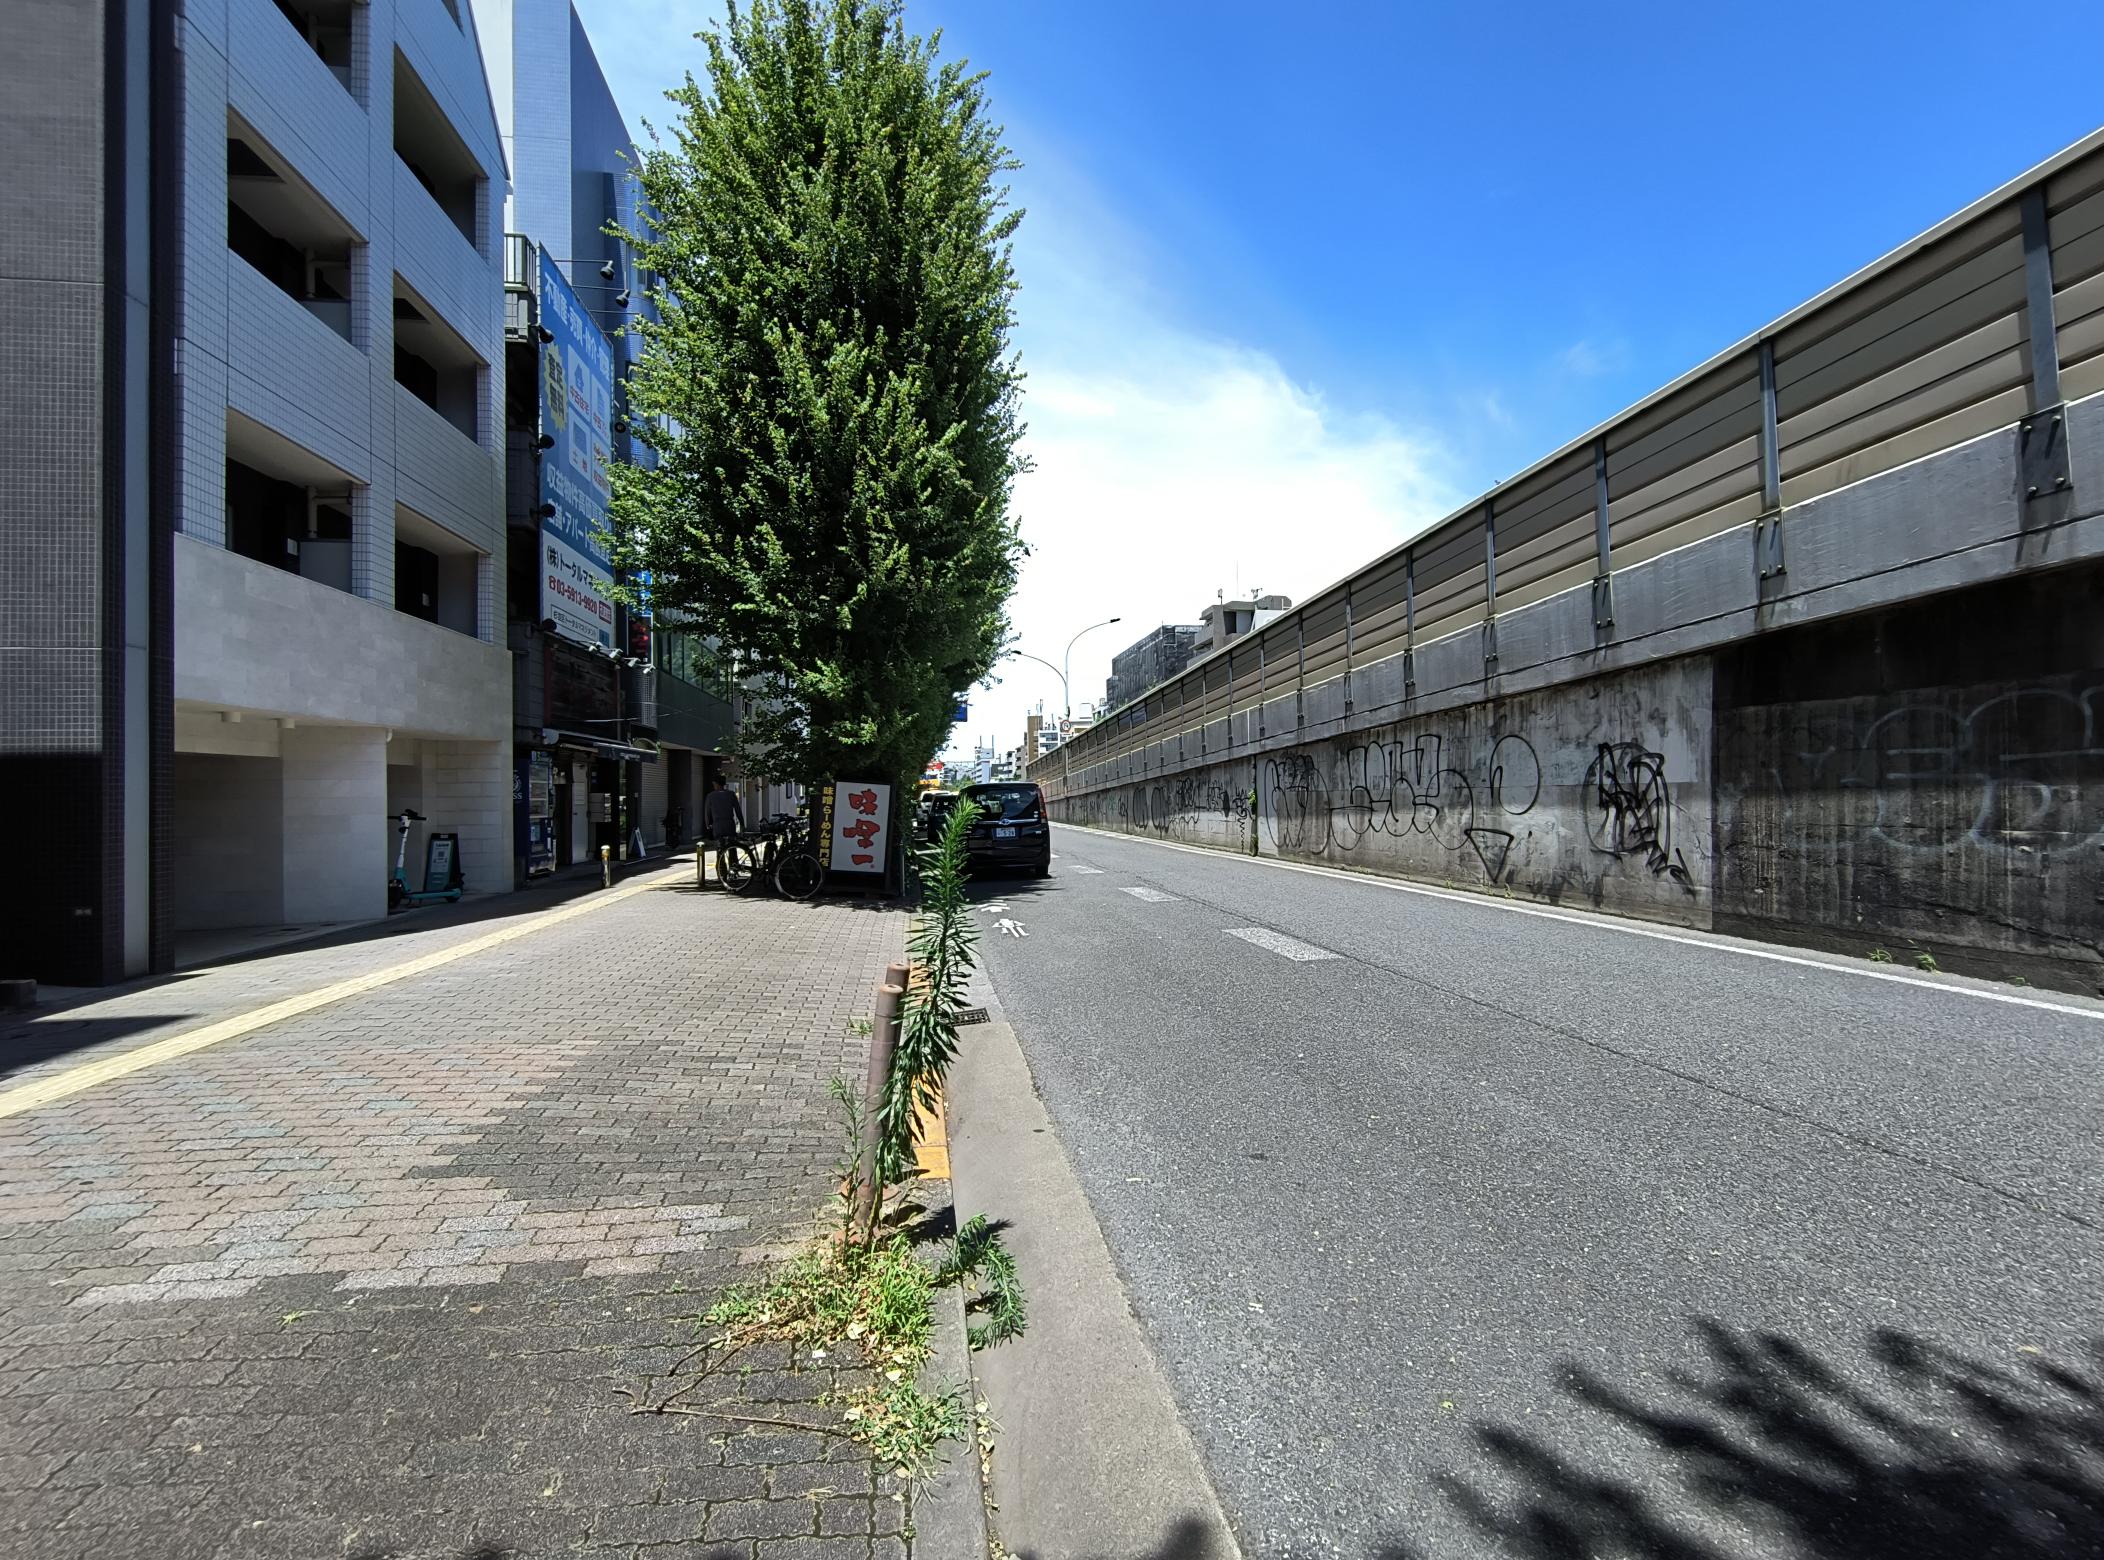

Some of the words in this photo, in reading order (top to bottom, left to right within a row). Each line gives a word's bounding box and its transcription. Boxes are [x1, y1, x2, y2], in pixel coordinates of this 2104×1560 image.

[819, 786, 834, 867] 味噌らーめん専門店
